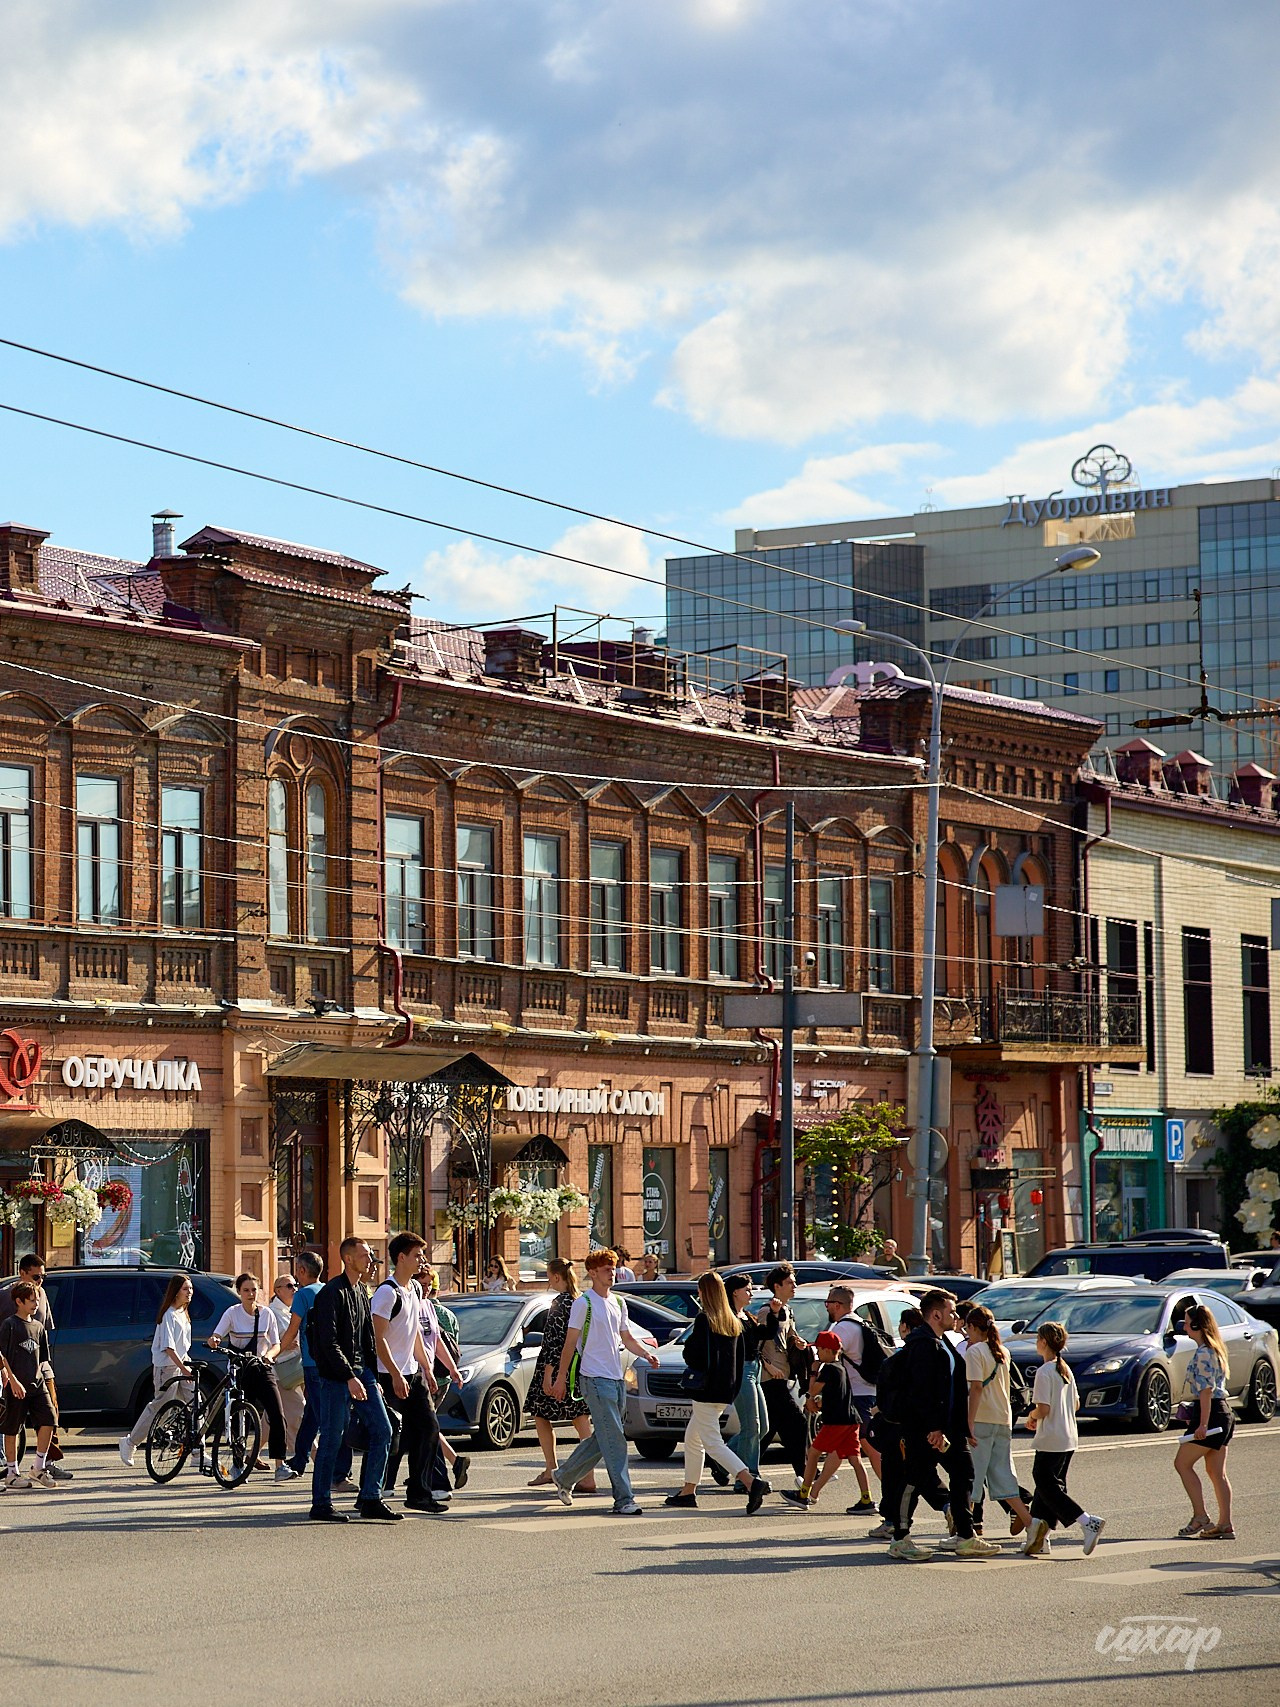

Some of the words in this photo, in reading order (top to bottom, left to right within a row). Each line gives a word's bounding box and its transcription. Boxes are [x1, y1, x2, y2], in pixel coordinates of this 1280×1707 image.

[1000, 488, 1171, 528] Дубровин
[62, 1055, 202, 1091] ОБРУЧАЛКА
[507, 1083, 608, 1114] ЮВЕЛИРНЫЙ
[610, 1090, 665, 1115] САЛОН
[593, 1152, 605, 1189] ПОМОЩЬ
[646, 1187, 660, 1197] СТАНЬ
